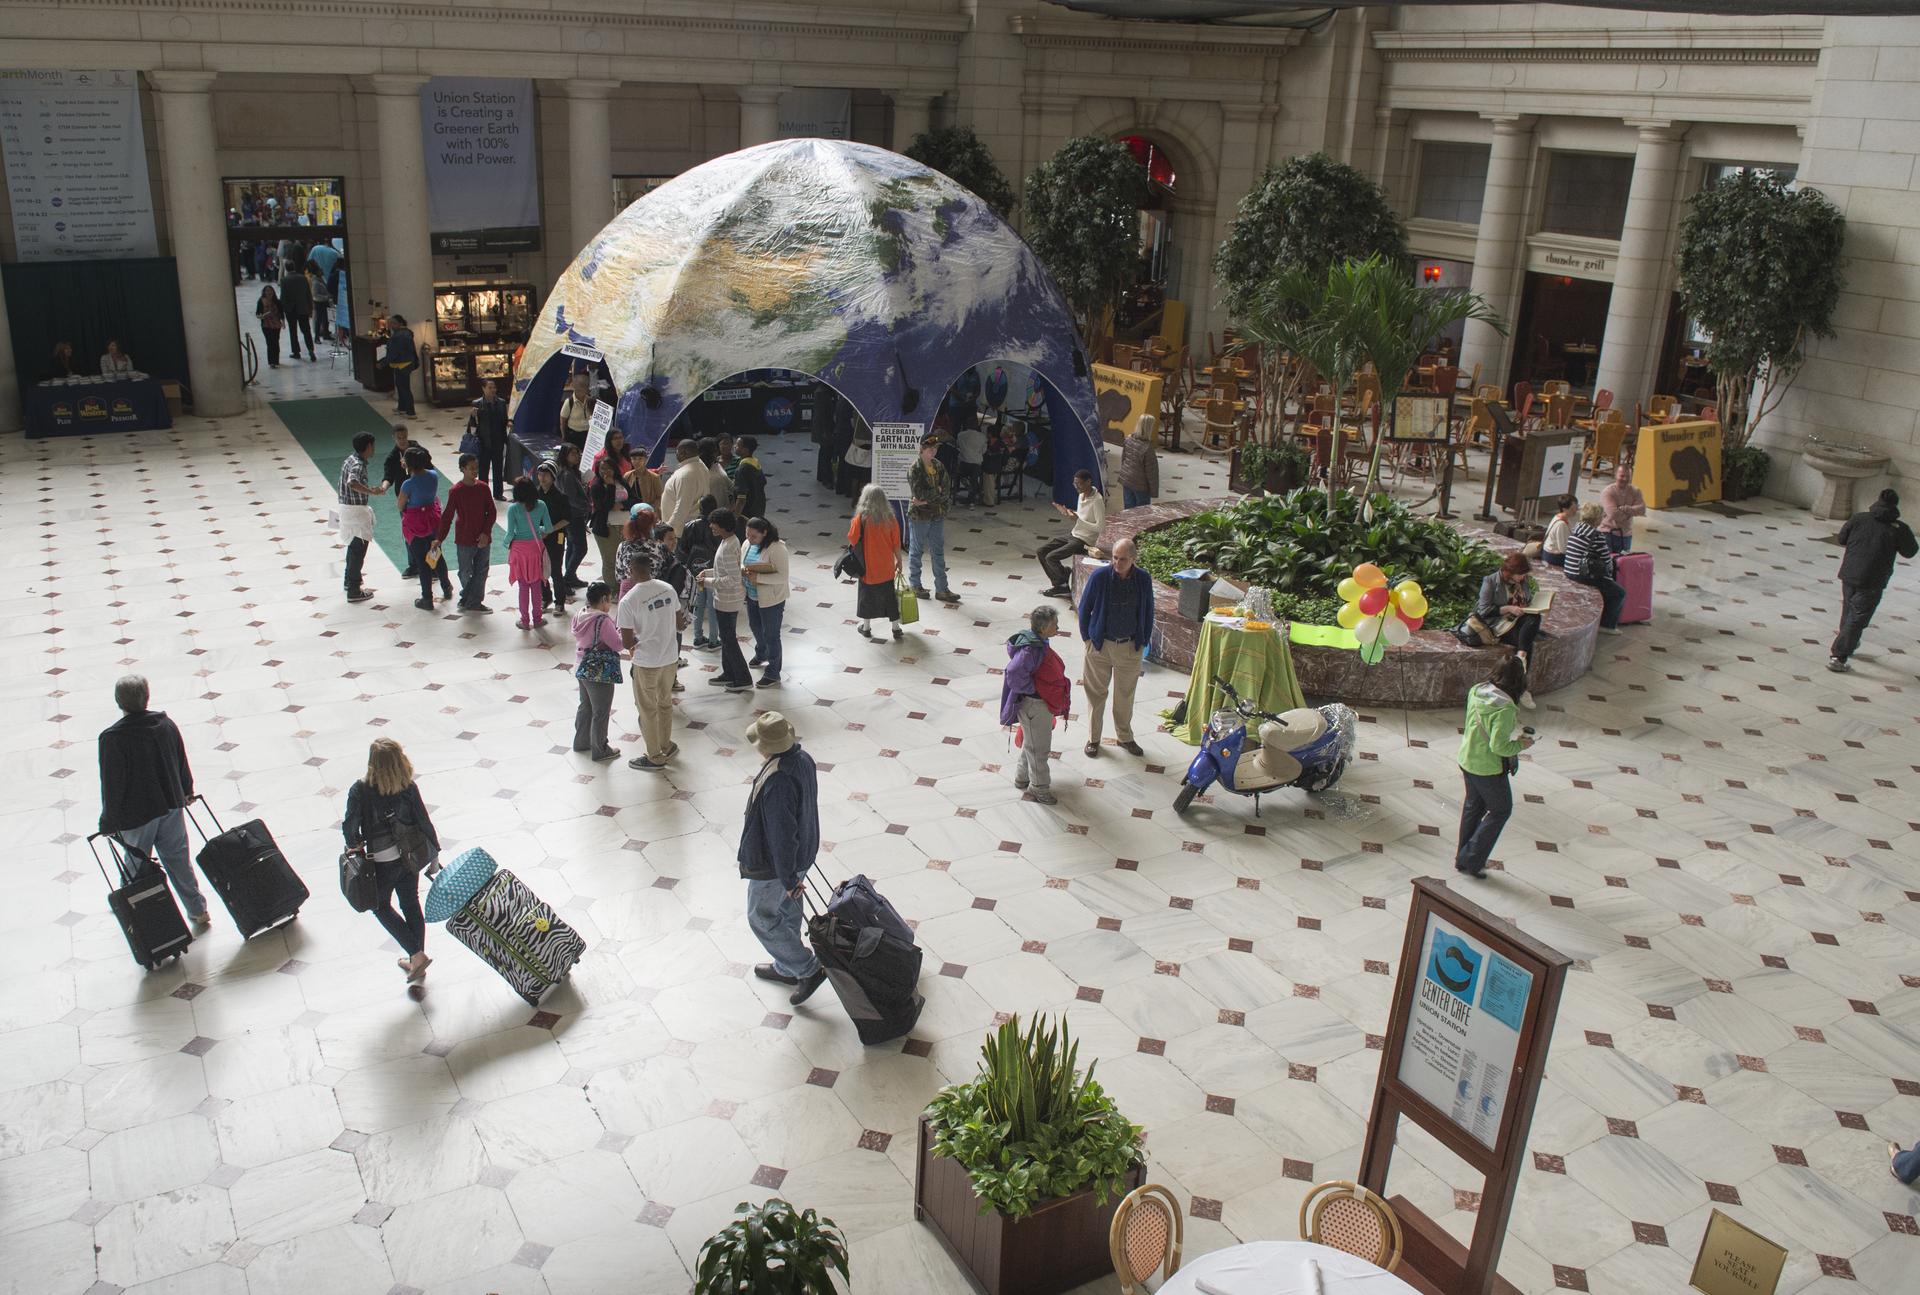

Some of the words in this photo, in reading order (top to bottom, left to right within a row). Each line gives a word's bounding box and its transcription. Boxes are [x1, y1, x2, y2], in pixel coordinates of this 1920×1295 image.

[0, 69, 63, 82] arthMonth
[433, 91, 470, 104] Union
[472, 91, 516, 104] Station
[437, 106, 447, 118] is
[450, 106, 503, 121] Creating
[507, 109, 514, 118] a
[433, 122, 483, 134] Greener
[487, 122, 519, 135] Earth
[778, 120, 817, 132] hMonth
[446, 138, 472, 150] with
[478, 137, 510, 150] 100%
[441, 153, 473, 165] Wind
[477, 153, 517, 165] Power.
[1545, 252, 1580, 267] thunder
[1583, 259, 1605, 271] grill
[766, 409, 793, 417] NASA
[876, 435, 903, 443] EARTH
[904, 435, 921, 443] DAY
[1421, 978, 1452, 1013] CENTER
[1450, 998, 1473, 1026] CAFE
[1419, 1000, 1440, 1019] UNION
[1440, 1015, 1468, 1038] STATION
[1724, 1249, 1757, 1274] PLEASE
[1727, 1260, 1748, 1276] SEAT
[1713, 1259, 1760, 1289] YOURSELF
